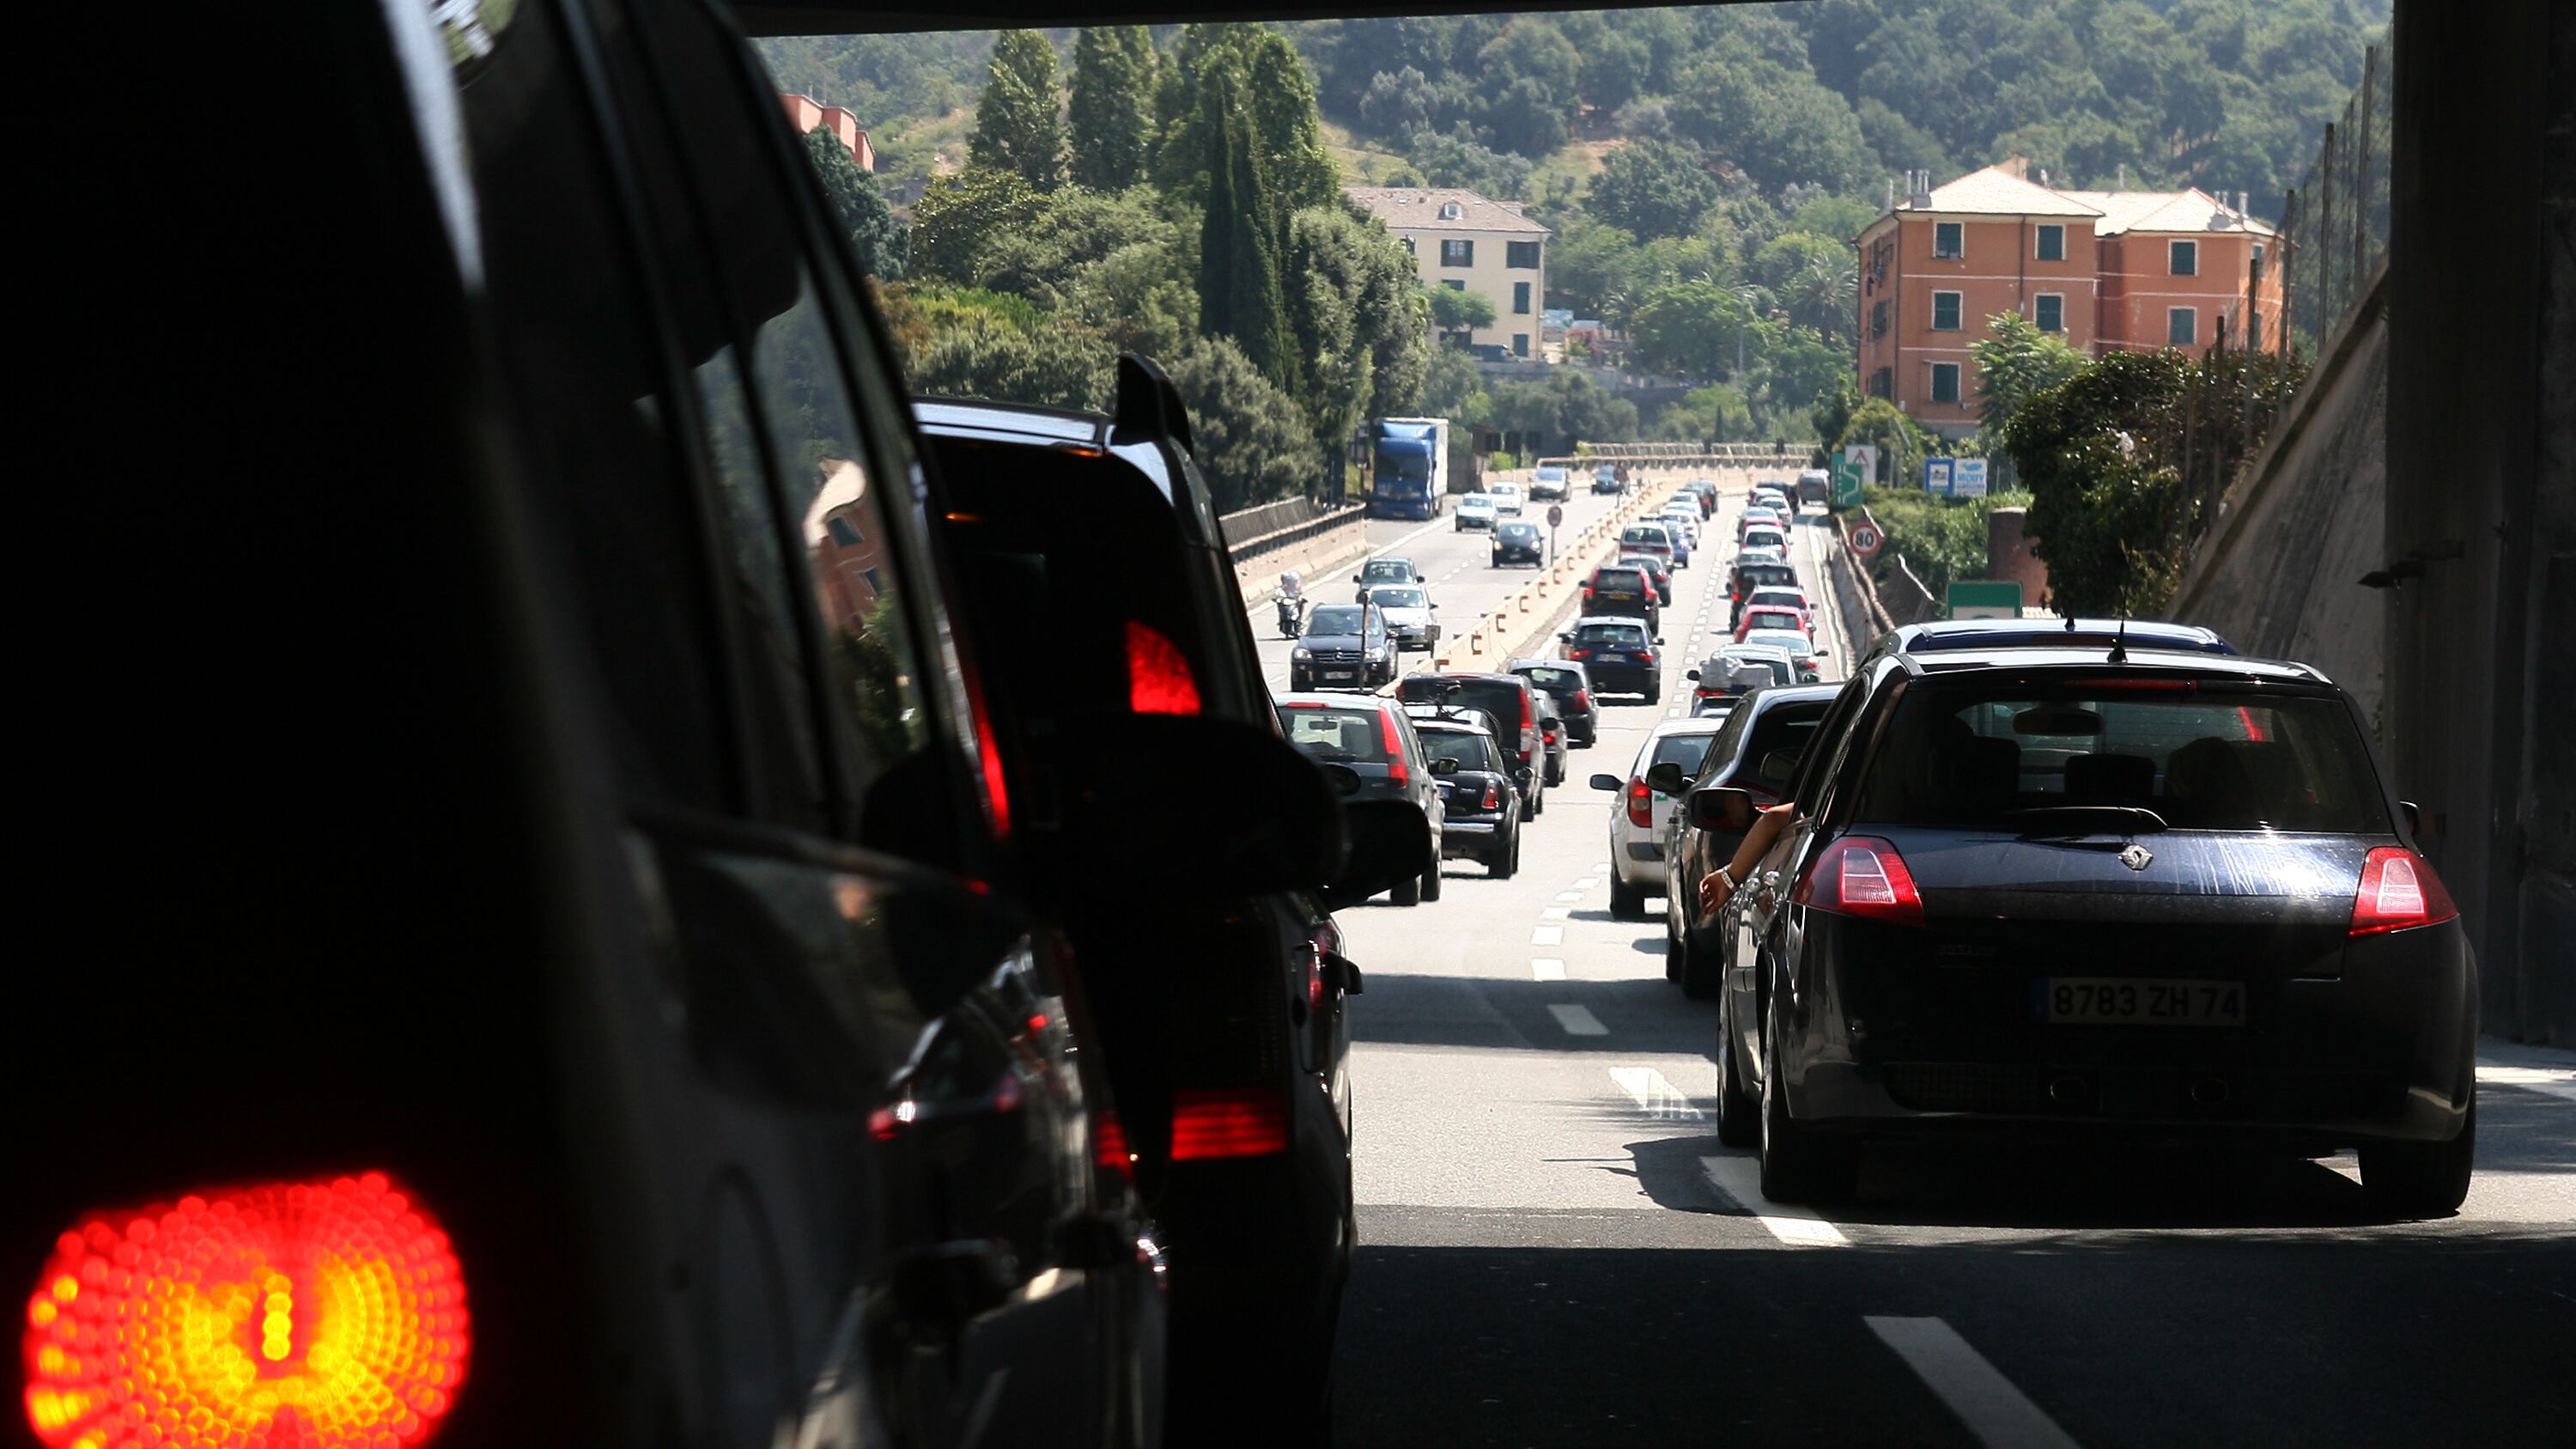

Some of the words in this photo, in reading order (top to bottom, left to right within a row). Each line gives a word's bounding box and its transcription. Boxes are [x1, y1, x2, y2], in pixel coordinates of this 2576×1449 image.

[1856, 533, 1874, 547] 80
[2054, 985, 2136, 1015] 8783
[2148, 986, 2189, 1017] ZH
[2200, 988, 2239, 1019] 74
